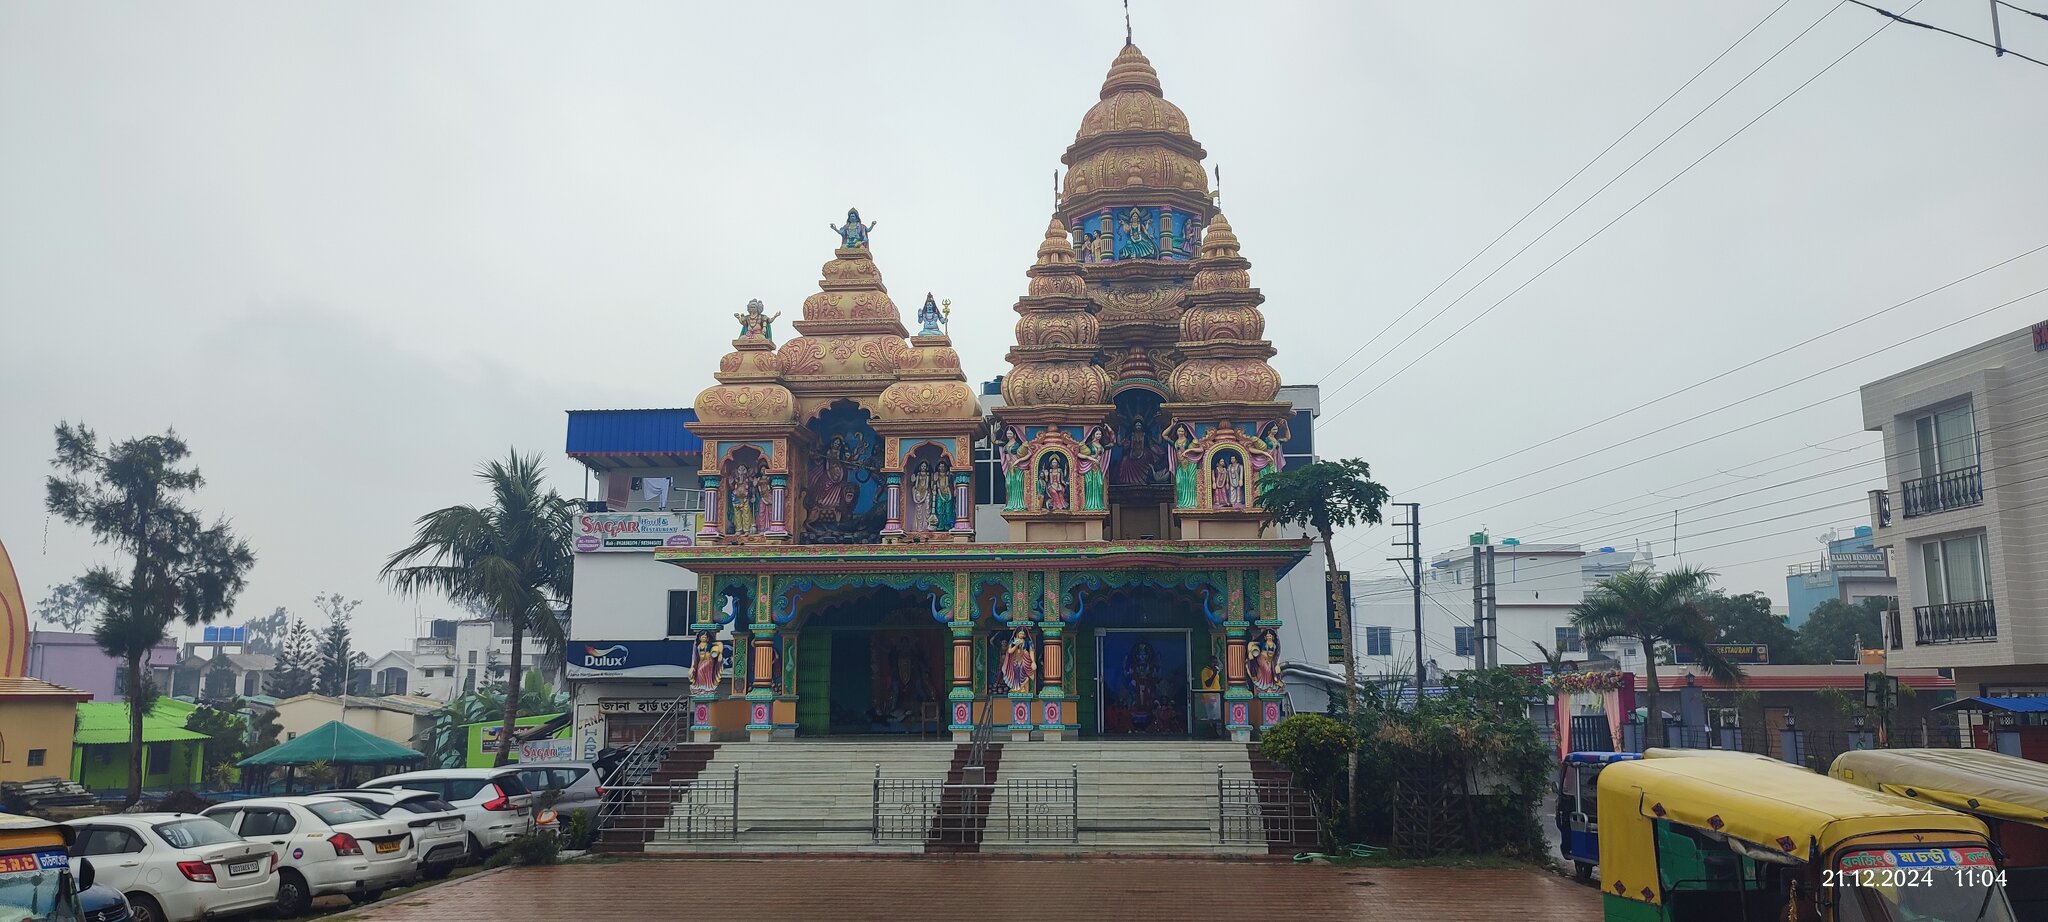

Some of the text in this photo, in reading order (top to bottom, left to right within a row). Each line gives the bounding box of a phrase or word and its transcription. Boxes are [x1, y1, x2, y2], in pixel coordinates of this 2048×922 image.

[581, 515, 640, 537] SAGAR
[1326, 574, 1348, 582] SAR
[584, 655, 622, 667] Dulux
[601, 700, 630, 711] জানা
[524, 744, 558, 760] SAGAR
[1900, 852, 1916, 863] মা
